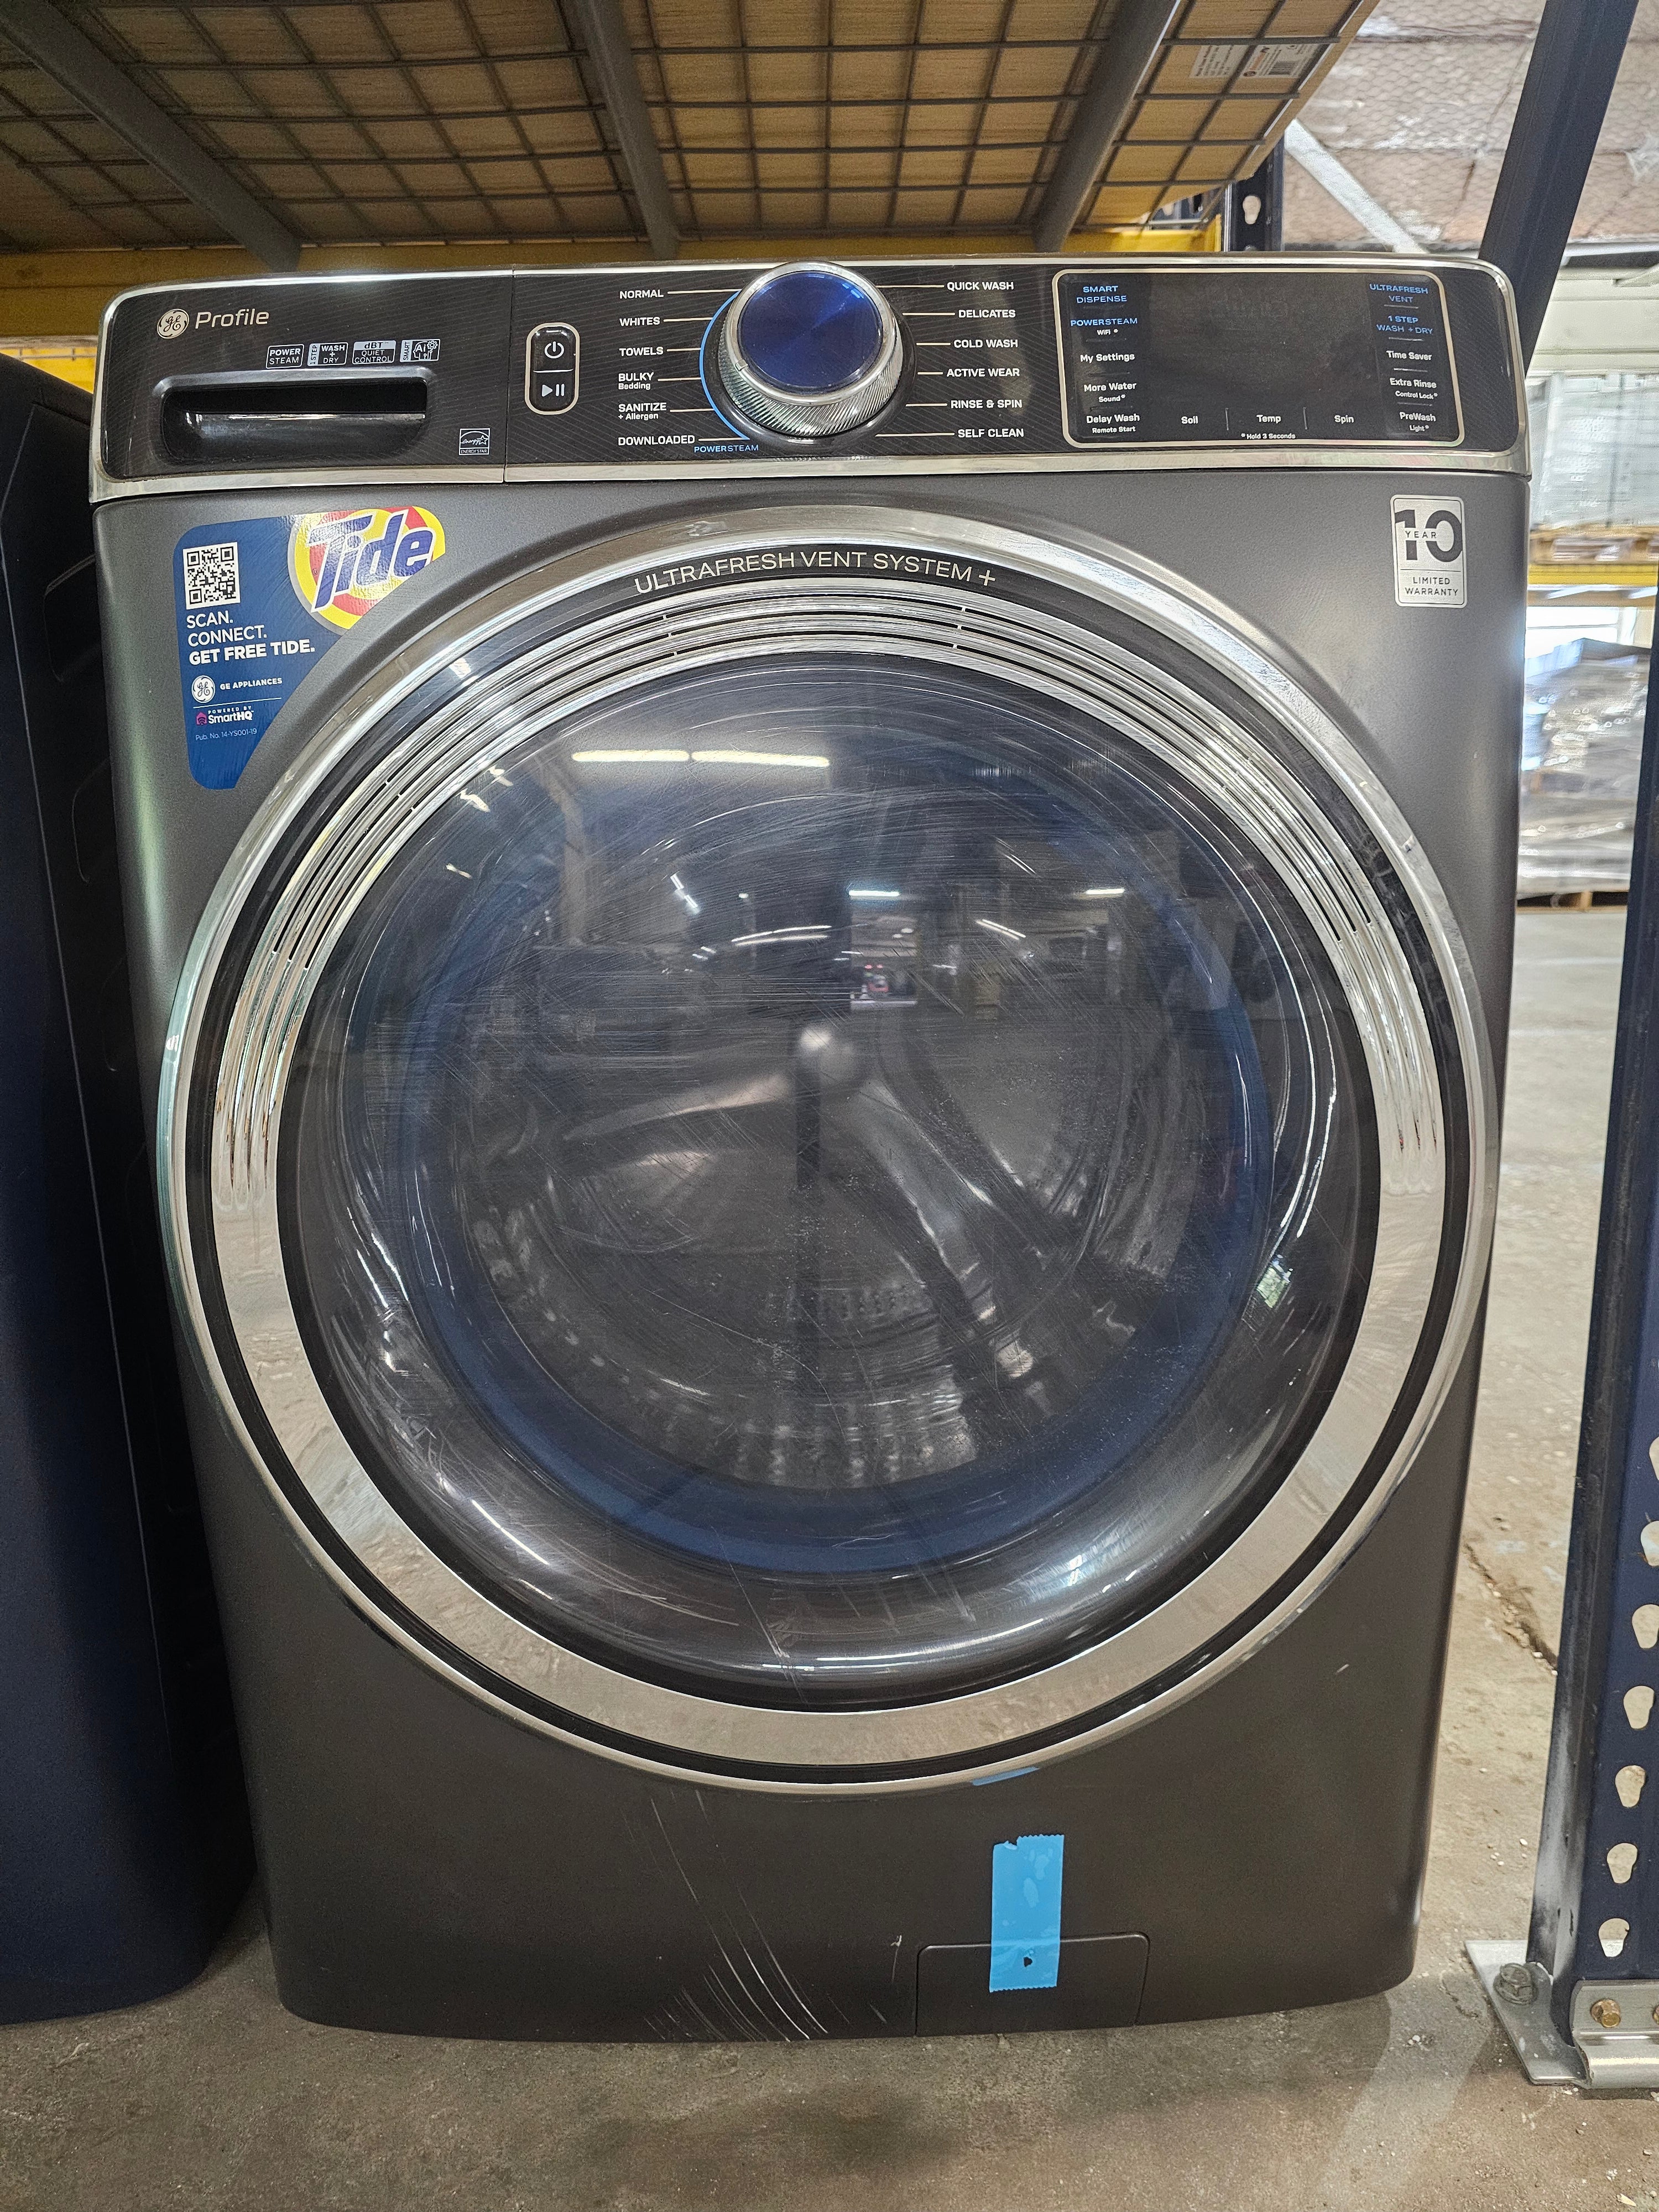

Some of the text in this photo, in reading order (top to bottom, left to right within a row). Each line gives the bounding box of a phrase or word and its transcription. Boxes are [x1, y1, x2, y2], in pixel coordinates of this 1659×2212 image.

[947, 281, 1014, 291] QUICK WASH
[1369, 284, 1428, 294] ULTRAFRESH
[619, 289, 664, 299] NORMAL
[195, 309, 269, 328] Profile
[958, 309, 1016, 318] DELICATES
[619, 317, 660, 326] WHITES
[1071, 318, 1138, 326] POWERSTEAM
[954, 339, 1018, 348] COLD WASH
[270, 348, 301, 356] POWER
[619, 347, 664, 357] TOWELS
[1386, 351, 1407, 359] Time
[1080, 353, 1135, 363] My Settings
[618, 372, 654, 382] BULKY
[947, 368, 1020, 377] ACTIVE WEAR
[618, 382, 651, 390] Bedding
[1390, 378, 1437, 388] Extra Rinse
[618, 403, 667, 412] SANITIZE
[997, 400, 1022, 409] SPIN
[625, 412, 659, 421] Allergen
[1087, 414, 1140, 424] Delay Wash
[1181, 416, 1198, 424] Soil
[1256, 415, 1281, 424] Temp
[1334, 415, 1354, 424] Spin
[1400, 412, 1436, 421] PreWash
[958, 429, 1024, 438] SELF CLEAN
[618, 435, 695, 446] DOWNLOADED
[1395, 509, 1463, 562] 10
[307, 509, 436, 612] Tide
[634, 552, 795, 594] ULTRAFRESH
[800, 551, 867, 568] VENT
[873, 554, 973, 582] SYSTEM
[186, 610, 233, 629] SCAN.
[188, 625, 267, 647] CONNECT.
[189, 639, 315, 665] GET FREE TIDE.
[233, 678, 282, 688] APPLIANCES
[208, 711, 252, 724] SmartHQ
[222, 728, 257, 737] 14-YS001-19
